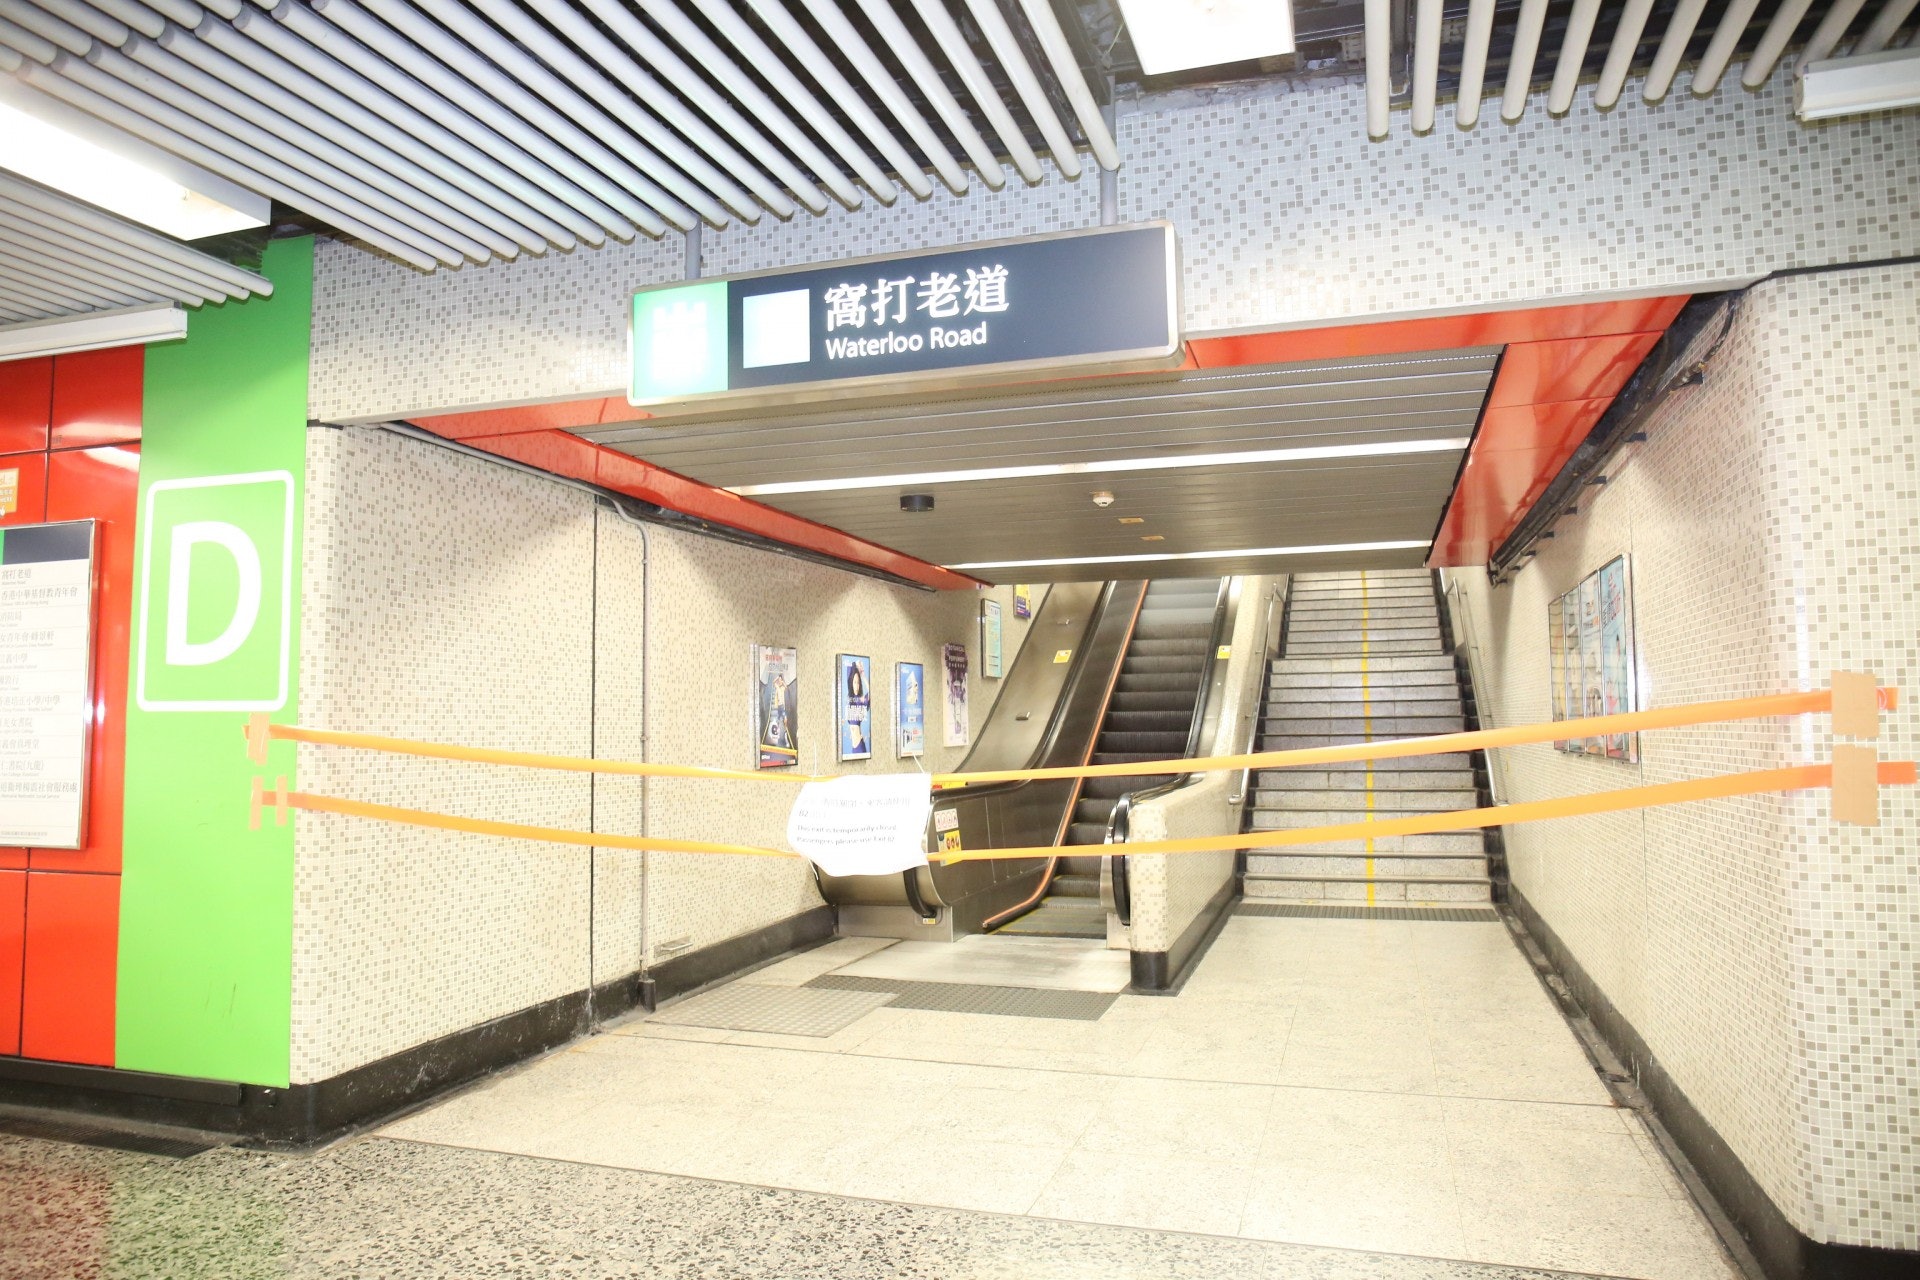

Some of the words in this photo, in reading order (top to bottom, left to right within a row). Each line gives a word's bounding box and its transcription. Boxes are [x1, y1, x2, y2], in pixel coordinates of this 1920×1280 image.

[824, 264, 1011, 332] 窩打老道
[825, 330, 923, 360] Waterloo
[930, 322, 988, 350] Road
[165, 520, 262, 666] D
[796, 836, 834, 846] Passengers
[835, 837, 858, 846] please
[833, 824, 875, 834] temporarily
